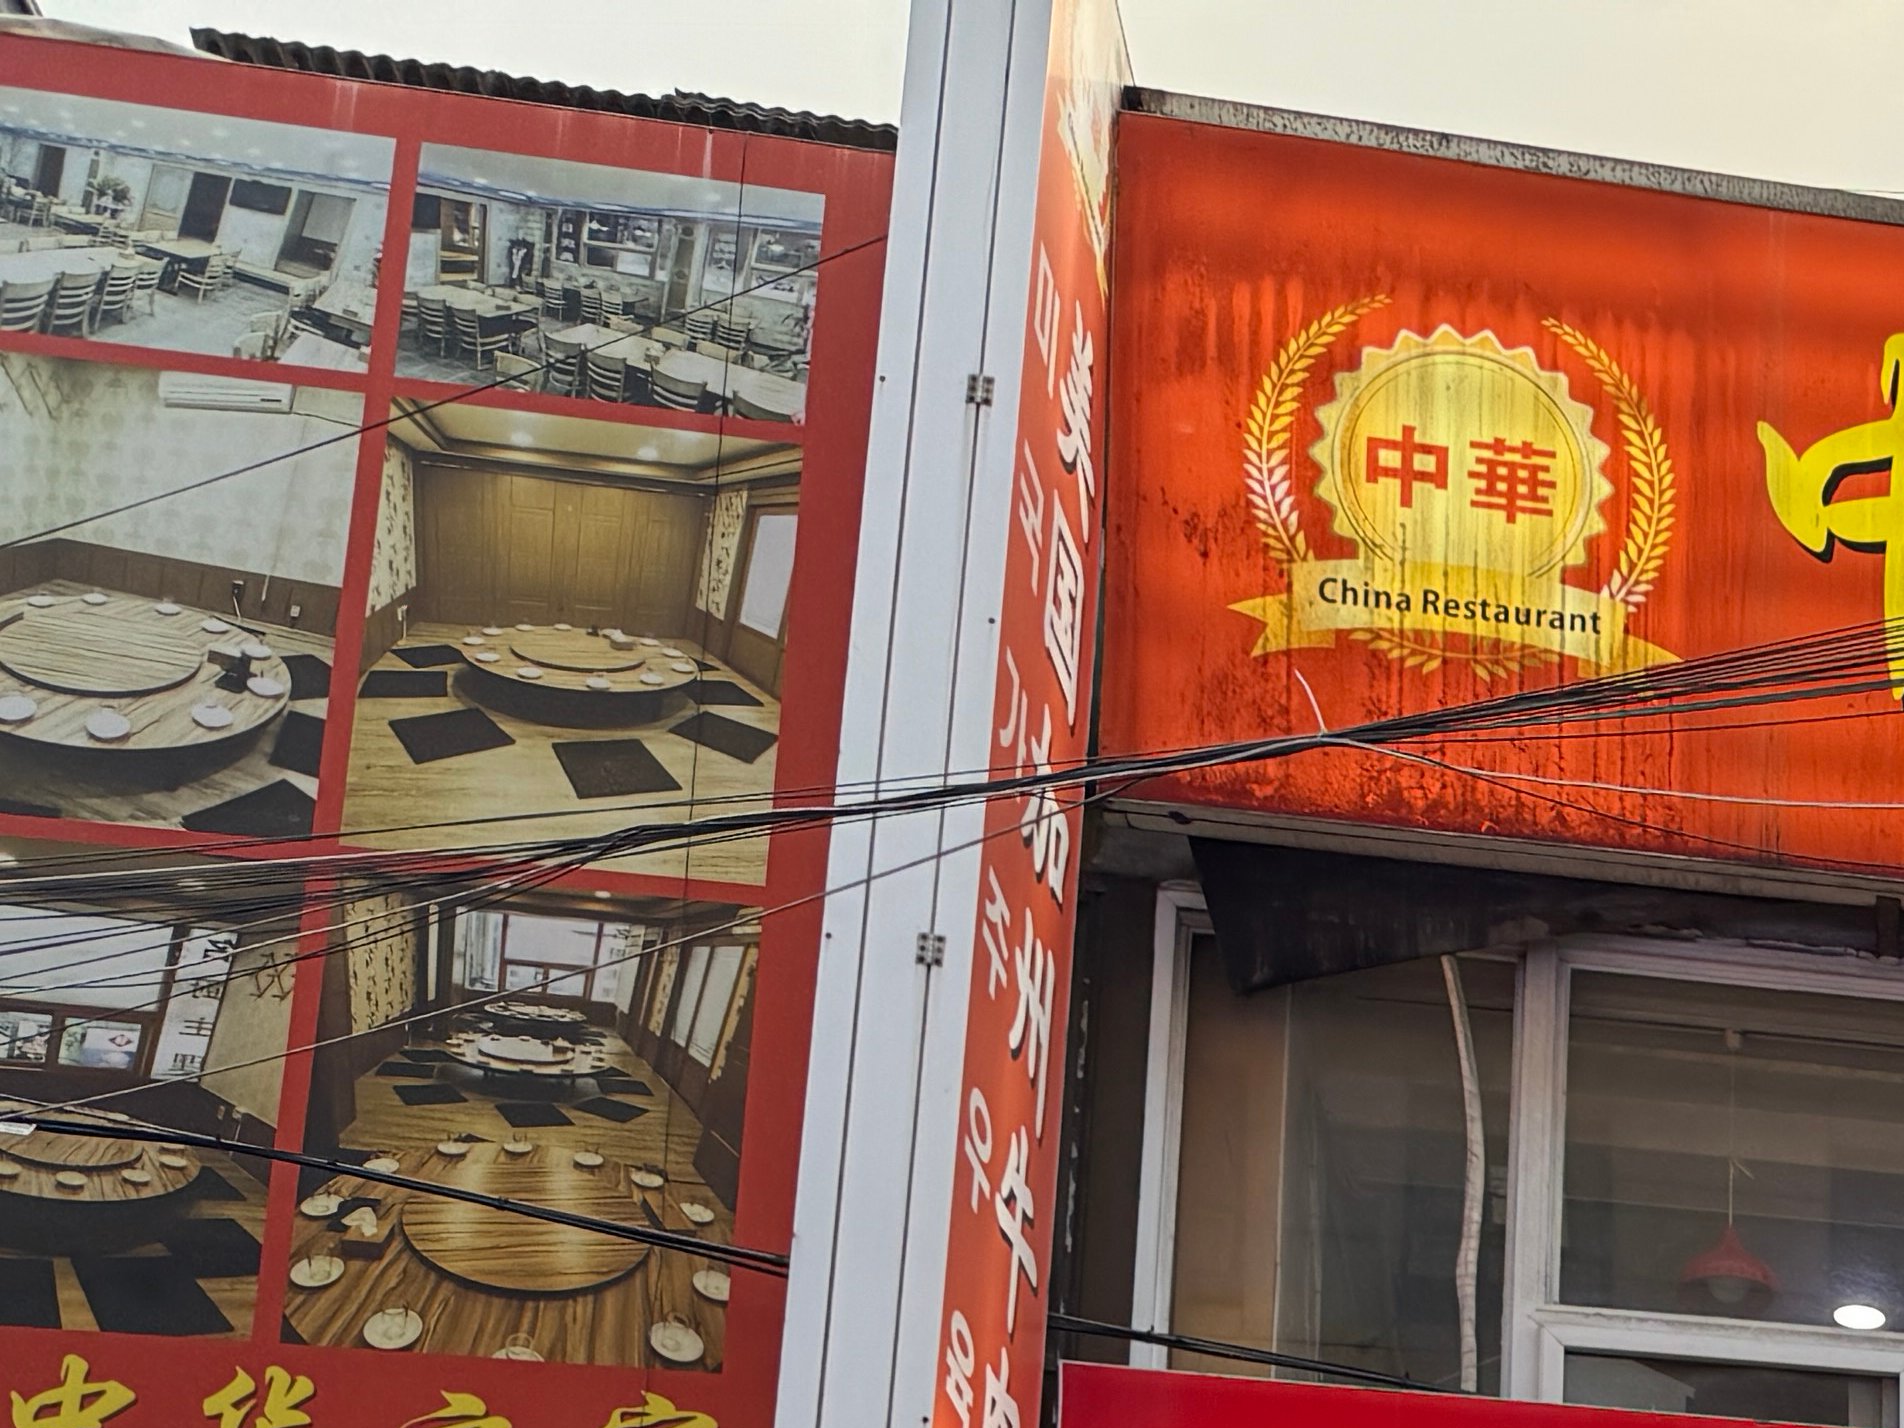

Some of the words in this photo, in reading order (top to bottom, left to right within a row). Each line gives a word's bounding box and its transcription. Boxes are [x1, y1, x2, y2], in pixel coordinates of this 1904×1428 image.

[1365, 424, 1557, 524] 中華
[1316, 576, 1413, 615] China
[1421, 588, 1602, 637] Restaurant
